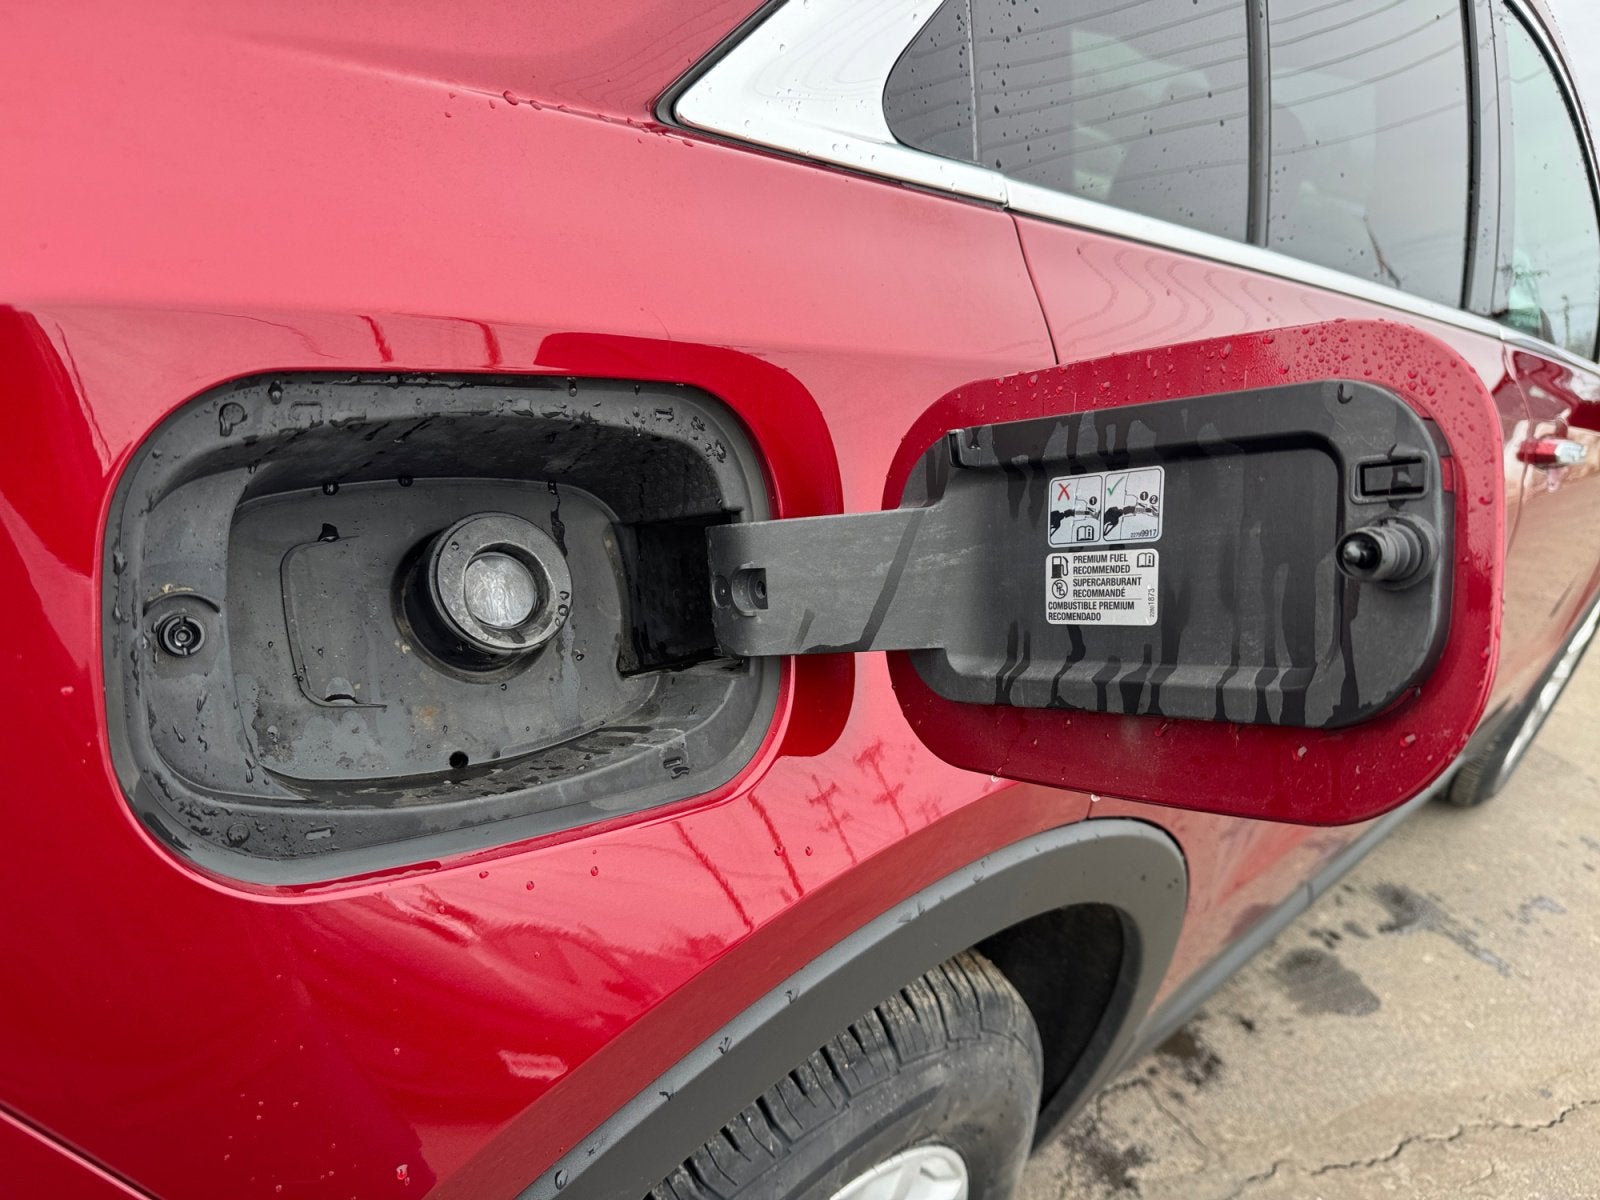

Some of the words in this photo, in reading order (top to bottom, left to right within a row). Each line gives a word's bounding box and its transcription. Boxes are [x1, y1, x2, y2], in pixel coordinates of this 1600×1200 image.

[1073, 555, 1107, 564] PREMIUM
[1109, 554, 1128, 563] FUEL
[1073, 564, 1130, 575] RECOMMENDED
[1073, 577, 1142, 587] SUPERCARBURANT
[1073, 587, 1126, 598] RECOMMANDÉ
[1048, 601, 1096, 610] COMBUSTIBLE
[1099, 601, 1135, 610] PREMIUM
[1048, 612, 1101, 621] RECOMENDADO
